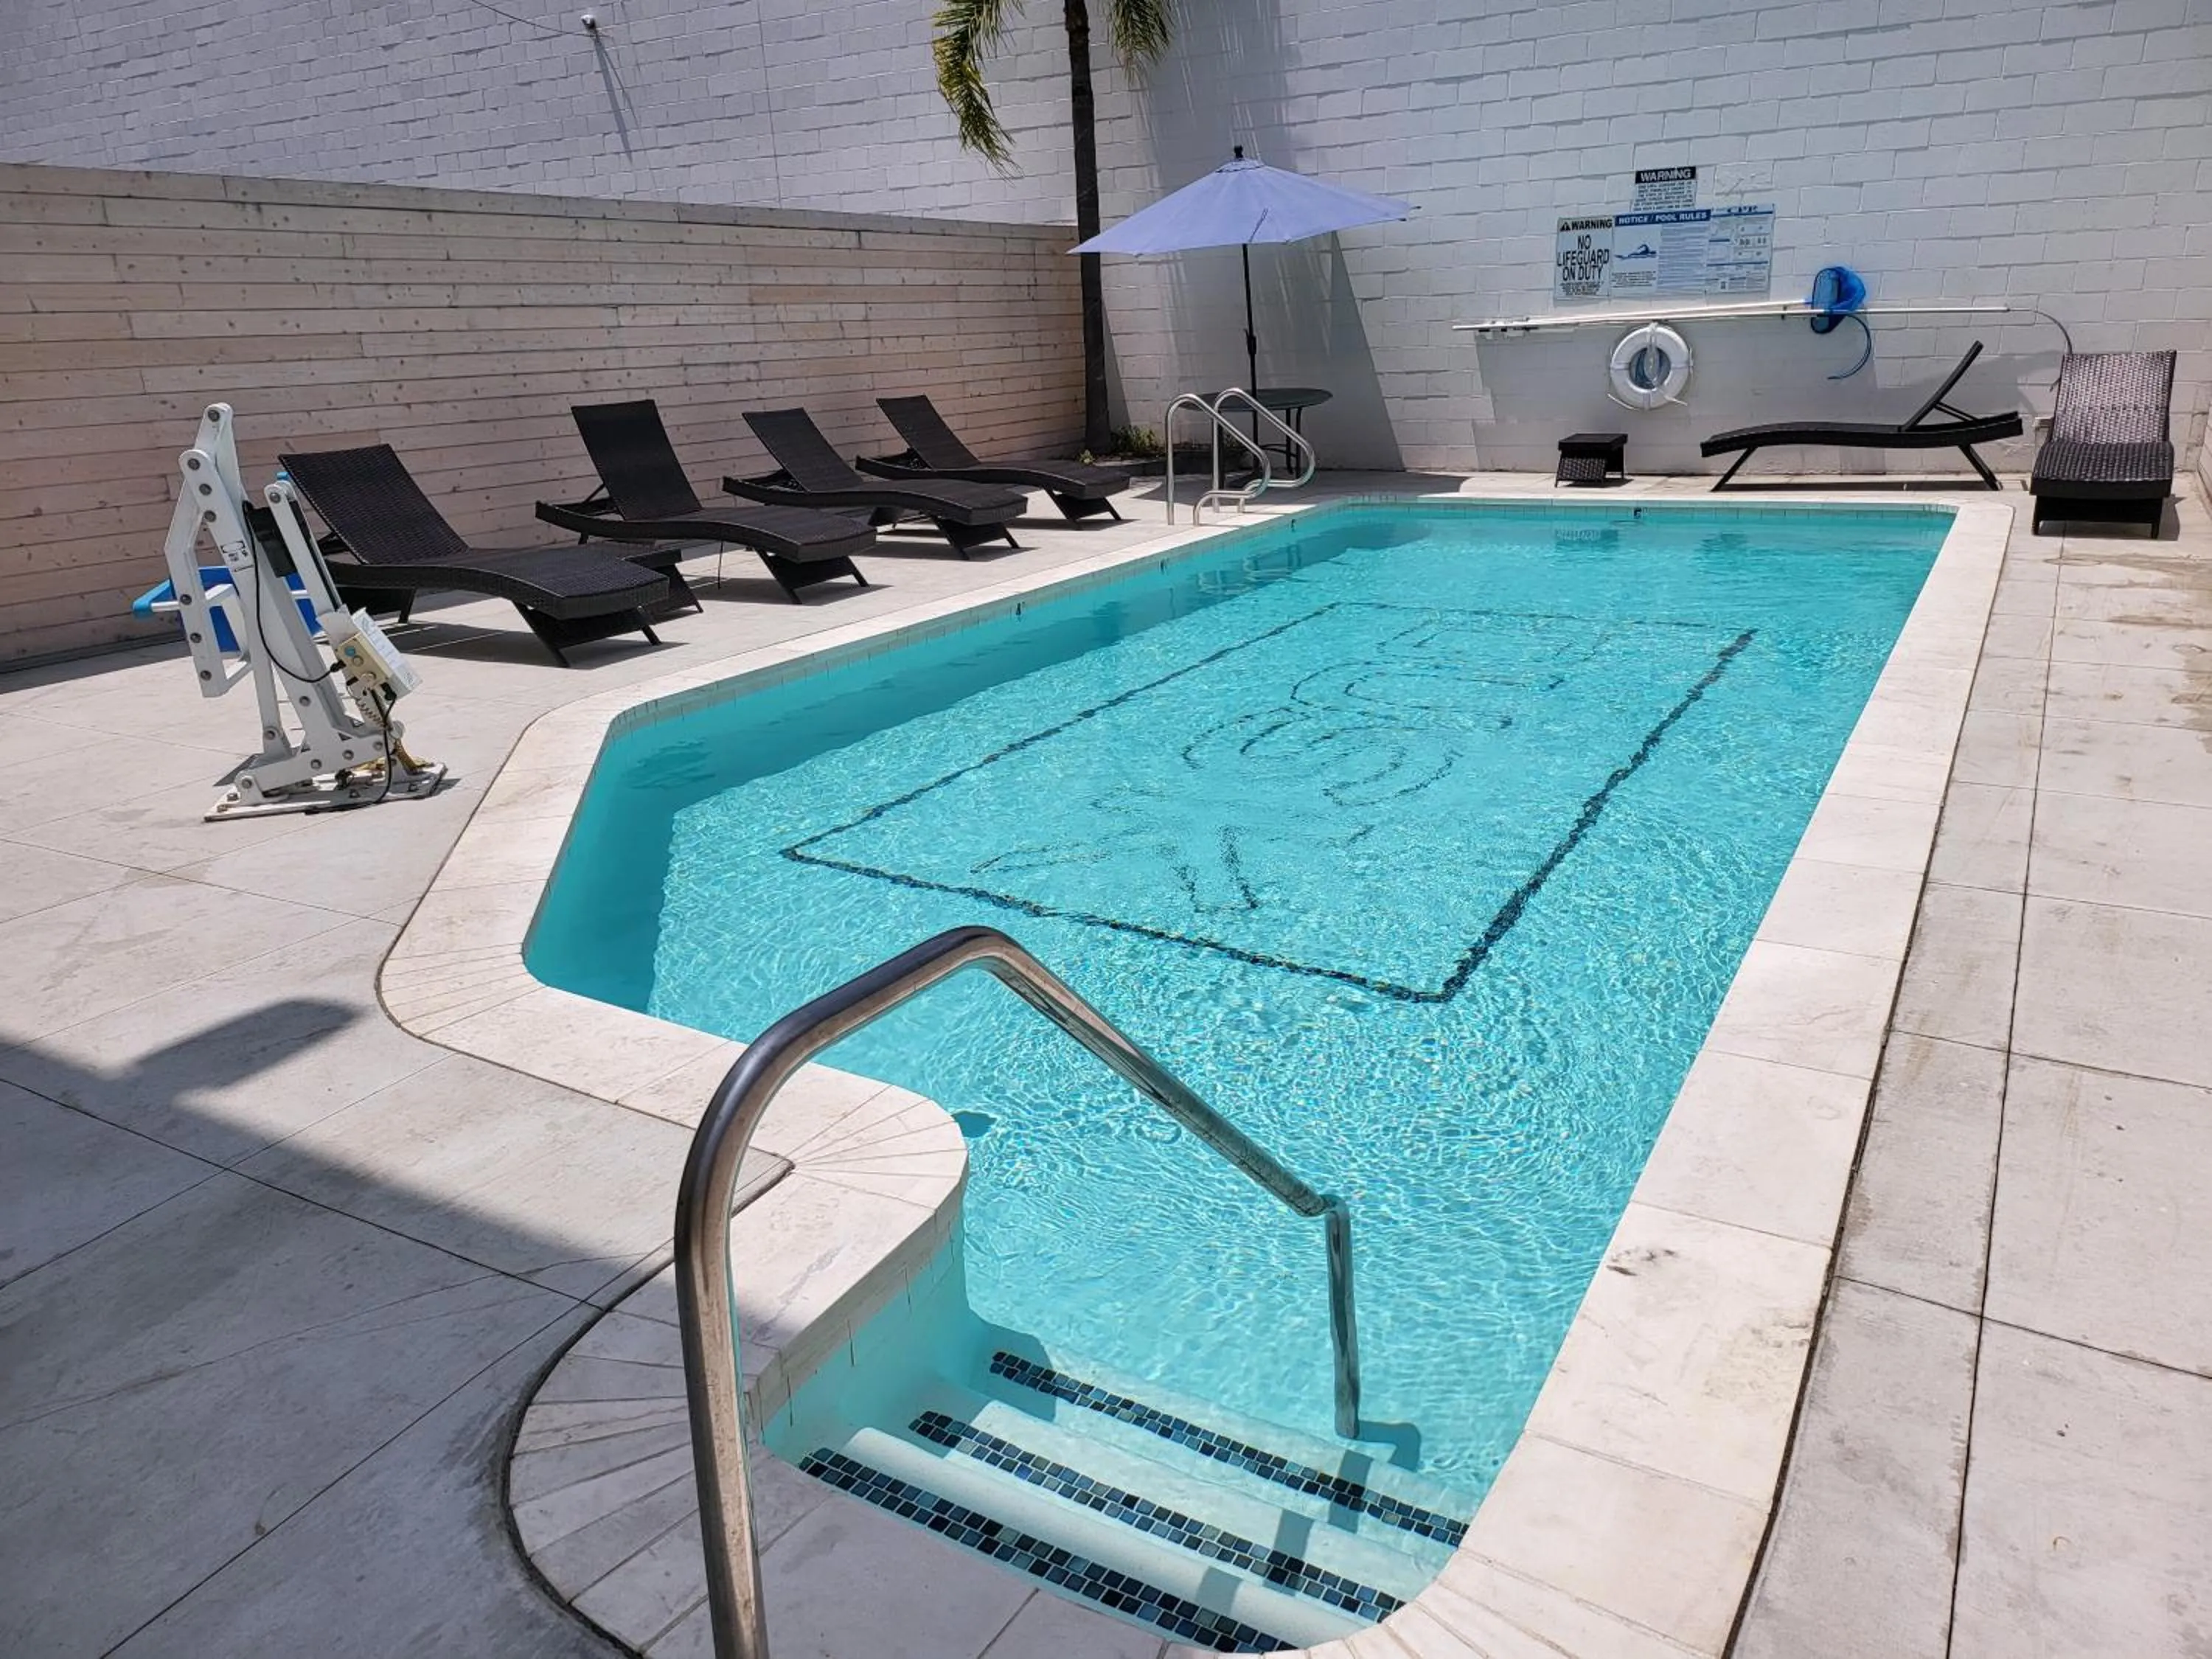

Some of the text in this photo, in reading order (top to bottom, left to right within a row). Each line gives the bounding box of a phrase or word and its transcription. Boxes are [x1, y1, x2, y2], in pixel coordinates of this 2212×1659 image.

[1641, 169, 1691, 182] WARNING
[1571, 219, 1613, 231] WARNING
[1618, 216, 1647, 225] NOTICE
[1680, 212, 1707, 220] RULES
[1577, 234, 1591, 249] NO
[1557, 249, 1610, 266] LIFEGUARD
[1562, 266, 1575, 281] ON
[1578, 265, 1604, 281] DUTY
